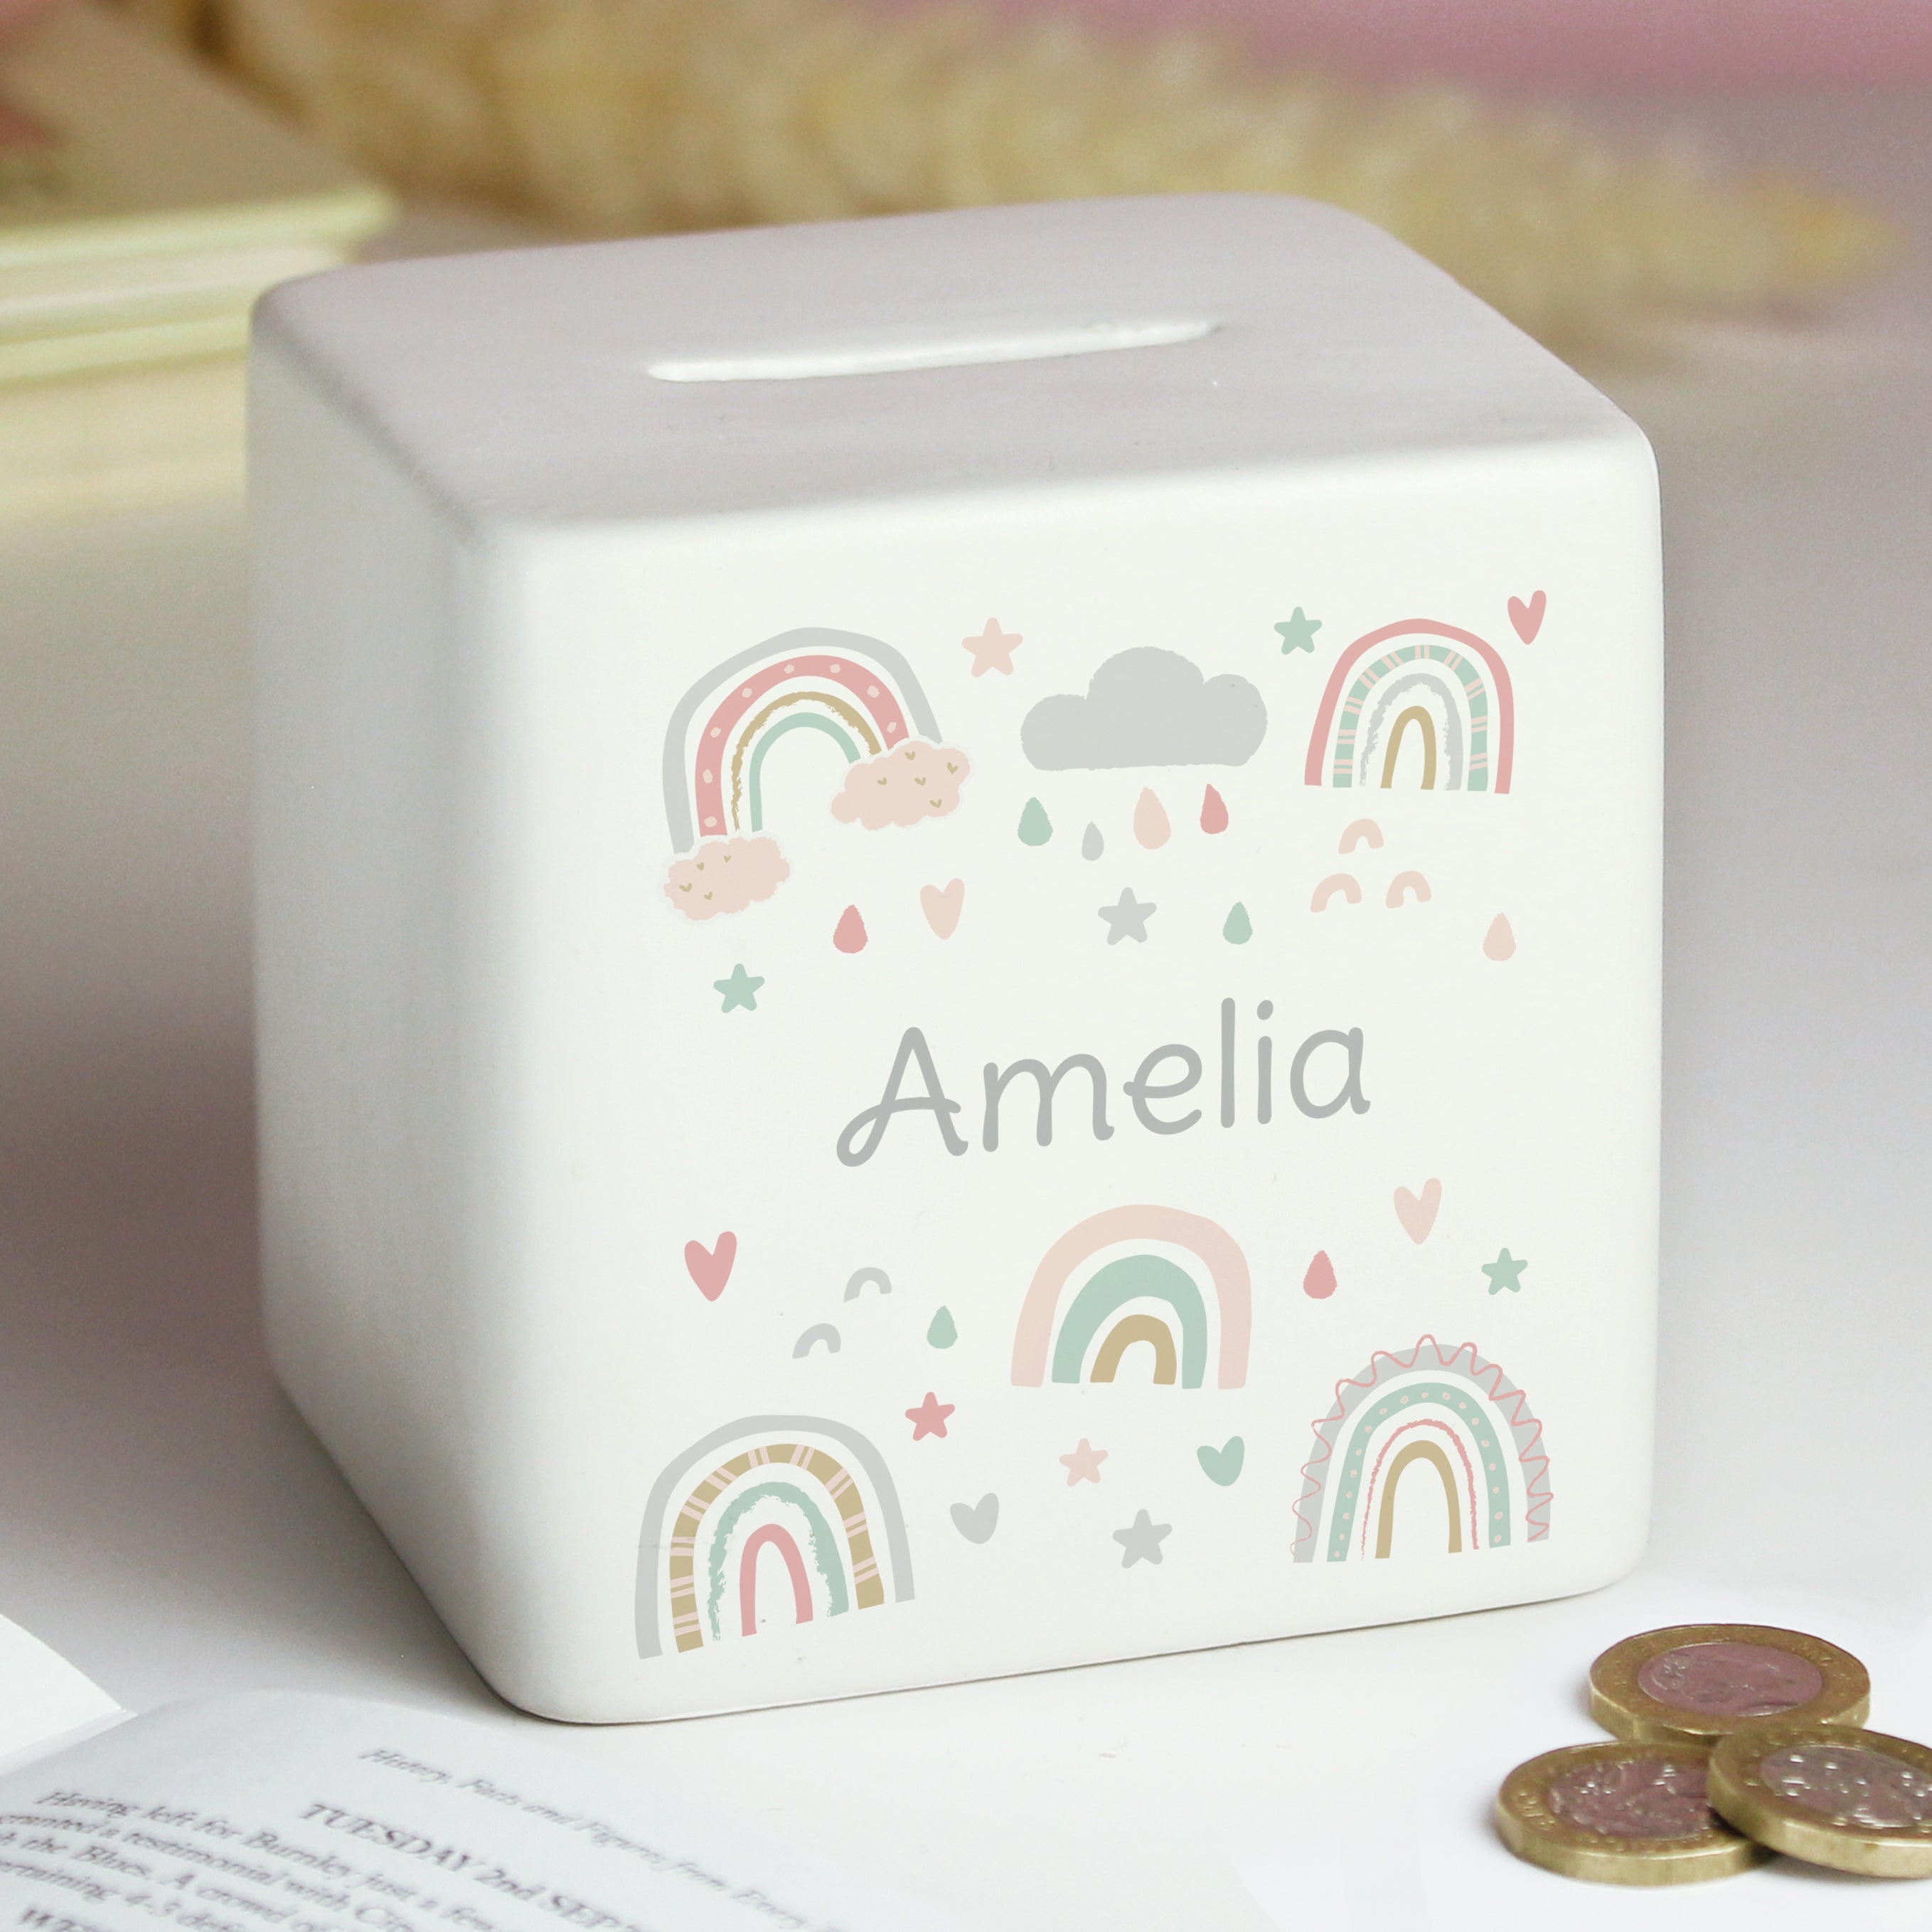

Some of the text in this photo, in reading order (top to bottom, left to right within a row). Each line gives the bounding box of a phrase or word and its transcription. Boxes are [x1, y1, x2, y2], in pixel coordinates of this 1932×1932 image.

[836, 998, 1371, 1167] Amelia
[19, 1837, 68, 1854] the
[156, 1873, 195, 1890] A
[196, 1888, 299, 1924] crowd
[34, 1790, 141, 1818] Having
[141, 1805, 198, 1828] left
[190, 1820, 242, 1839] for
[240, 1830, 360, 1879] Burnley
[344, 1872, 417, 1901] just
[122, 1832, 289, 1886] testimonial
[284, 1880, 350, 1911] with
[297, 1803, 486, 1872] TUESDAY
[472, 1869, 546, 1901] 2nd
[457, 1778, 522, 1806] Facts
[522, 1804, 583, 1825] and
[649, 1861, 728, 1891] from
